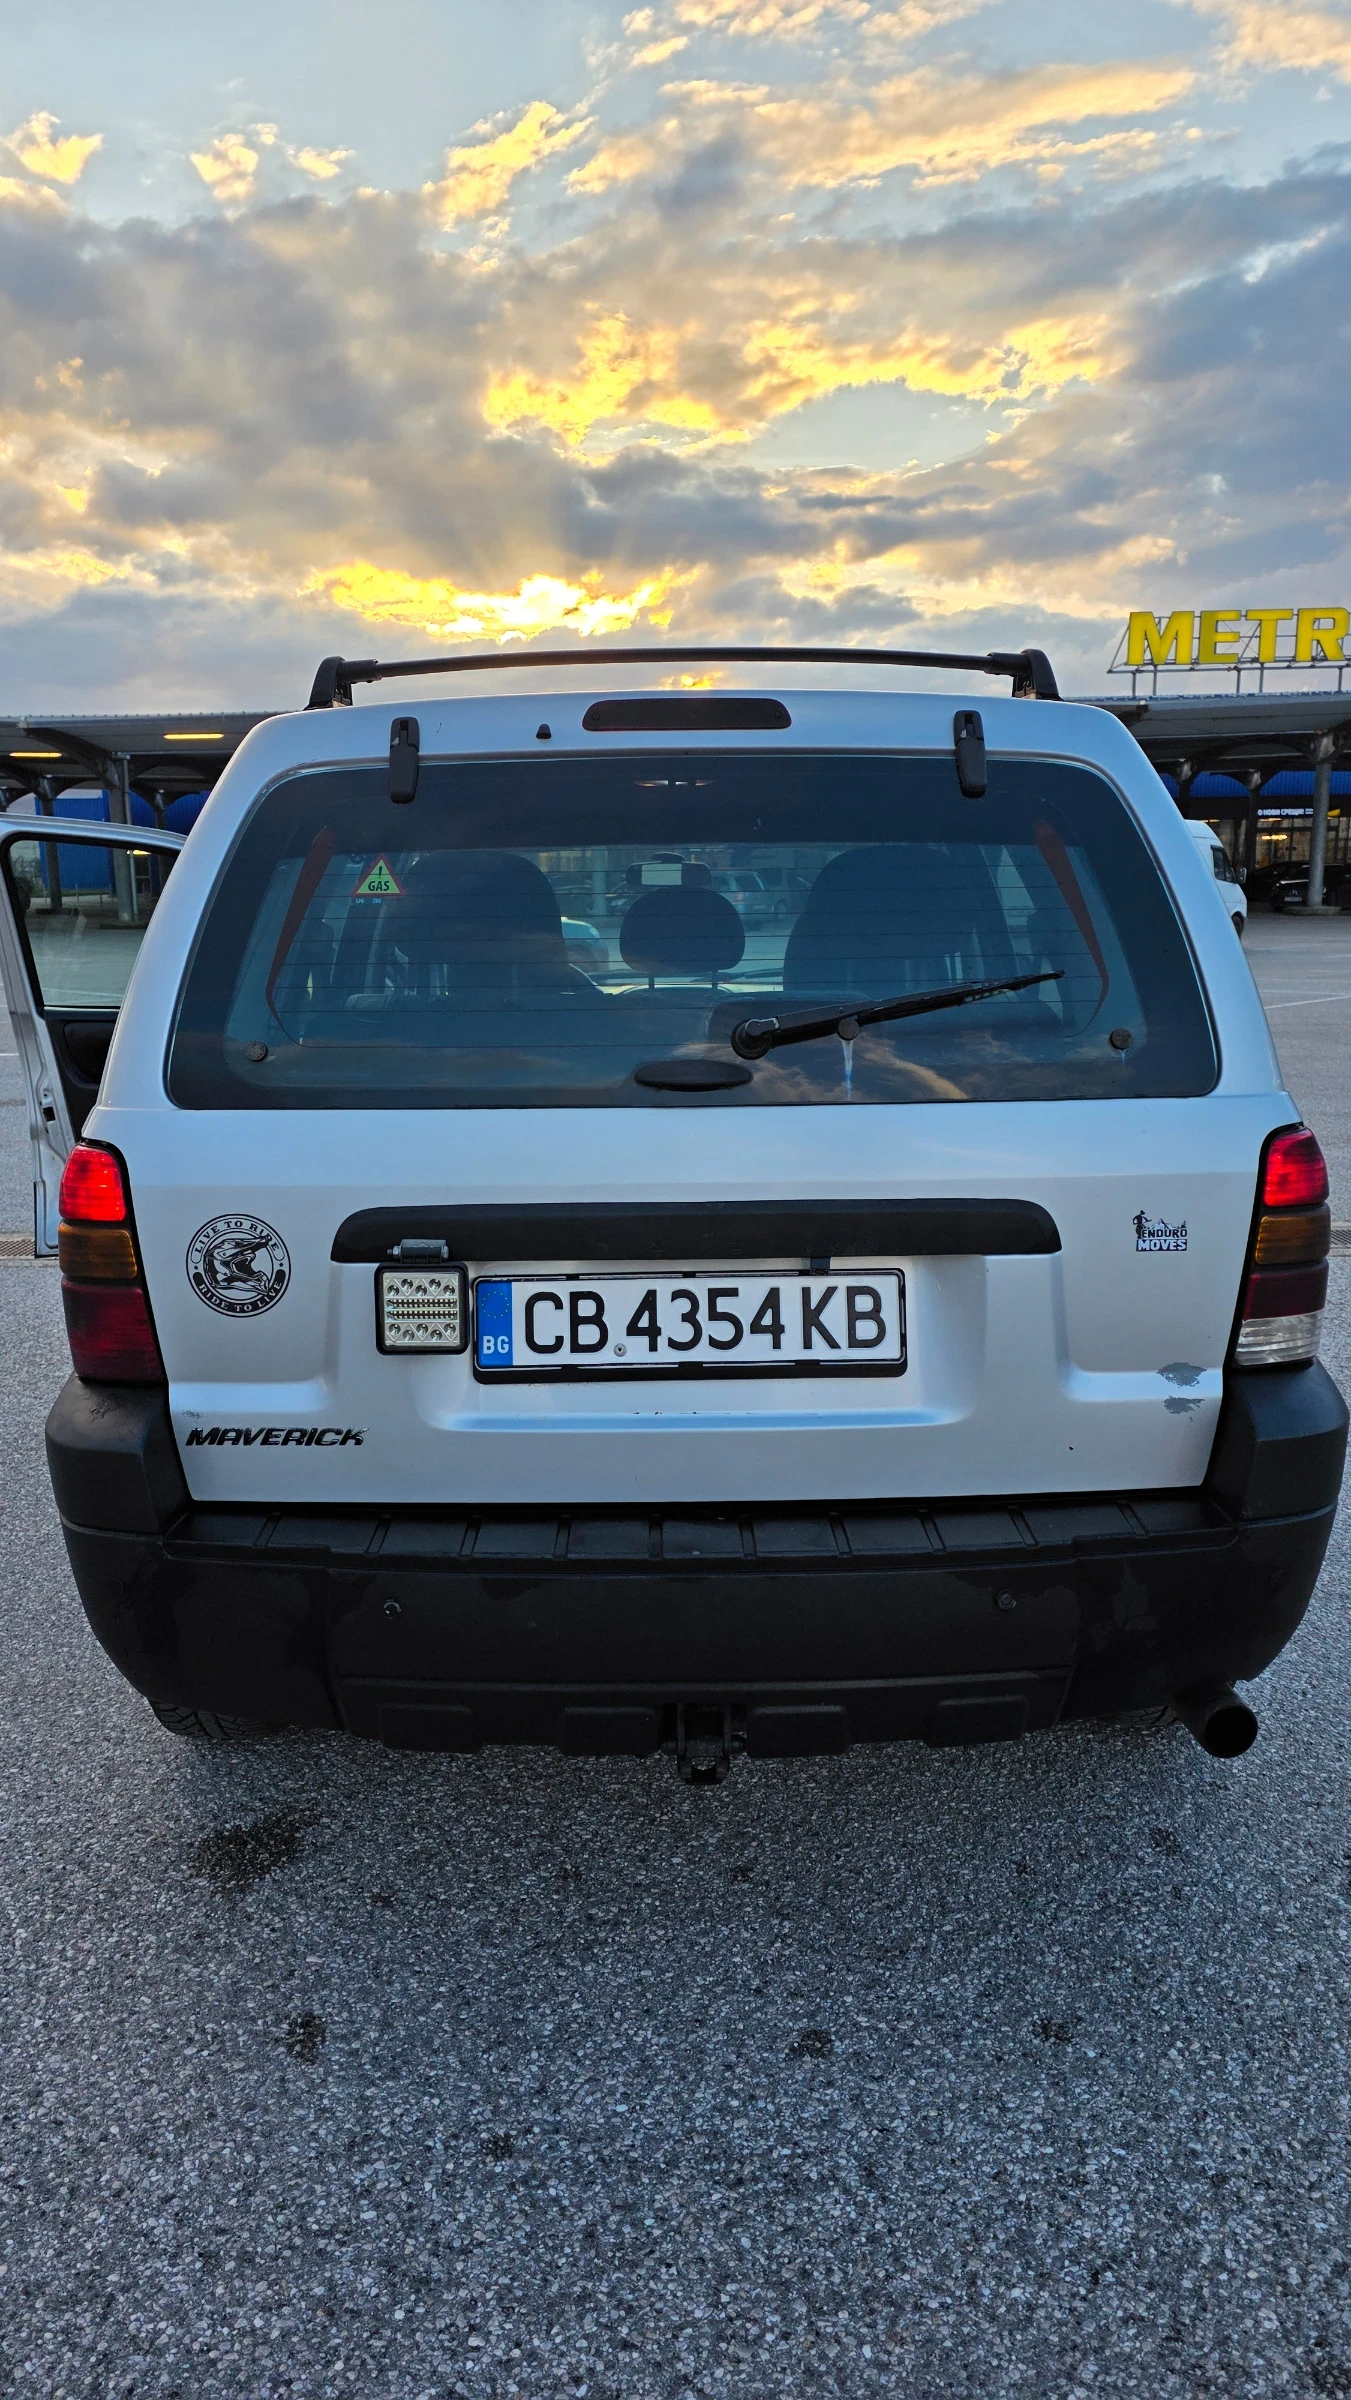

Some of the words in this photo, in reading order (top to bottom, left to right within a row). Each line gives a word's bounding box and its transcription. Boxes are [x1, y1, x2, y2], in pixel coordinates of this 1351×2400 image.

[368, 881, 390, 891] GAS
[195, 1225, 220, 1254] LIVE
[224, 1220, 243, 1229] TO
[249, 1223, 280, 1251] RIE
[1141, 1229, 1188, 1238] ENDURO
[1138, 1239, 1187, 1251] MOVES
[199, 1283, 229, 1310] RIDE
[234, 1303, 253, 1312] TO
[257, 1281, 282, 1308] LIVE
[625, 1286, 785, 1353] 4354
[483, 1335, 509, 1355] BG
[185, 1427, 369, 1446] MAVERICK
